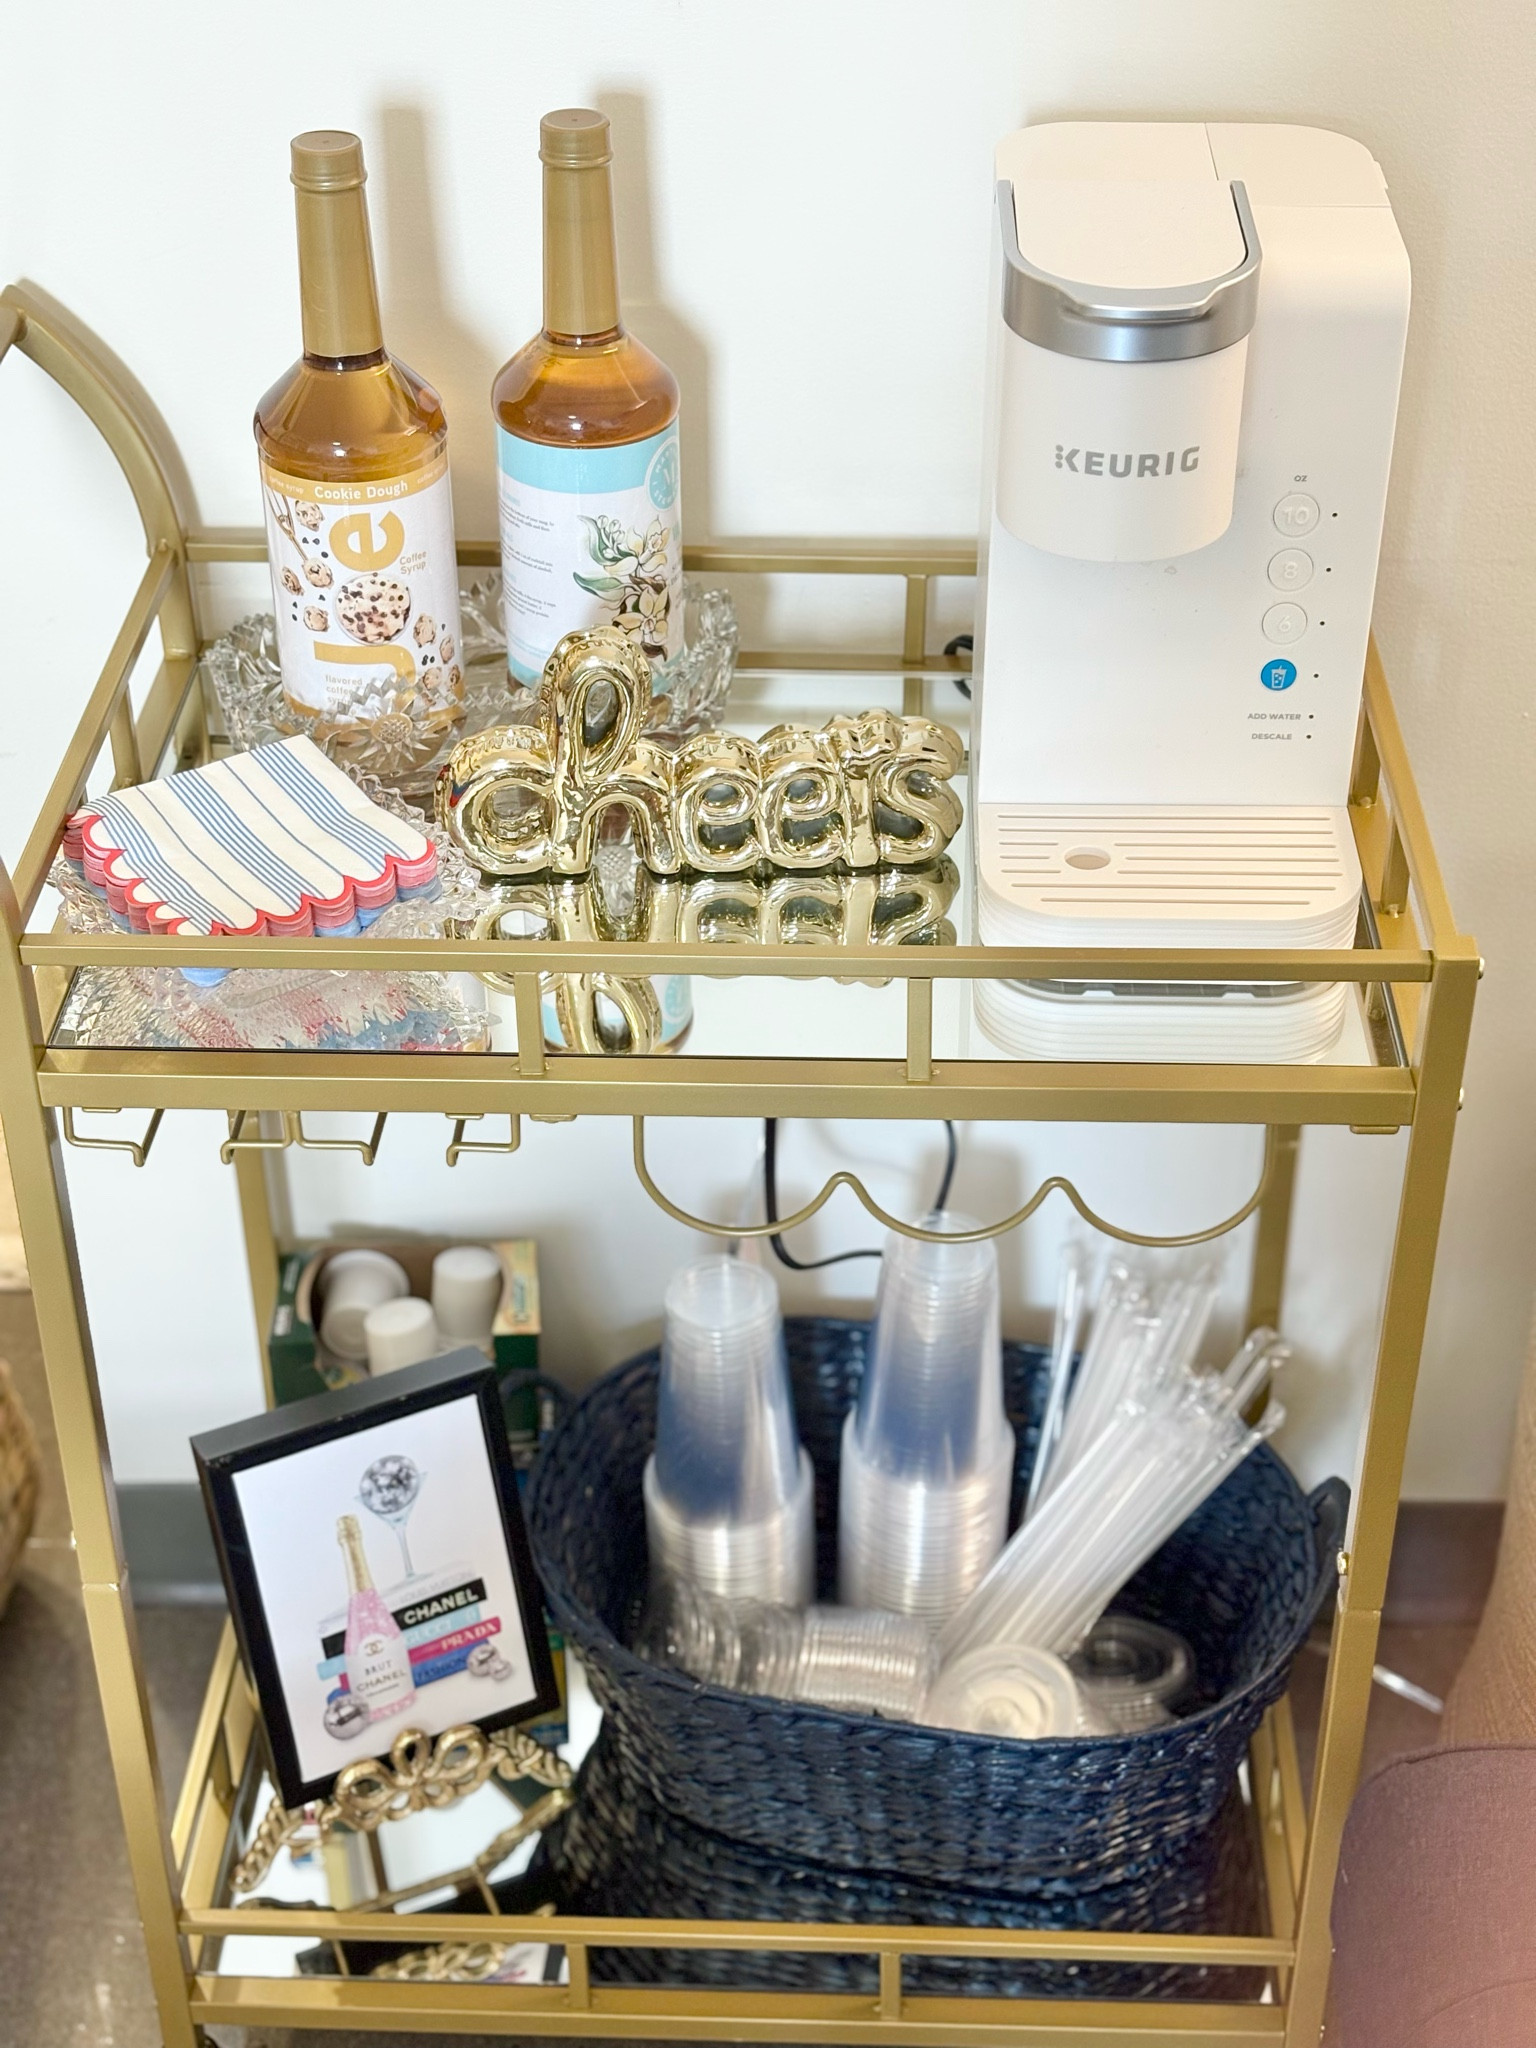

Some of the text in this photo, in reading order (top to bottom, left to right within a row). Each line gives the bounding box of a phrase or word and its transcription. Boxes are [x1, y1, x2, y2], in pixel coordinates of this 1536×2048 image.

[1055, 444, 1200, 478] KEURIG
[314, 480, 409, 500] Cookie Dough
[1284, 506, 1310, 525] 10
[399, 551, 427, 566] Coffee
[399, 560, 427, 575] Syrup
[1284, 561, 1298, 579] 8
[1278, 615, 1291, 633] 6
[325, 674, 363, 686] flavored
[1269, 713, 1302, 721] WATER
[434, 626, 964, 876] cheers
[403, 1588, 479, 1625] CHANEL
[441, 1622, 498, 1652] PRADA
[364, 1660, 392, 1676] BRUT
[355, 1669, 407, 1693] CHANEL
